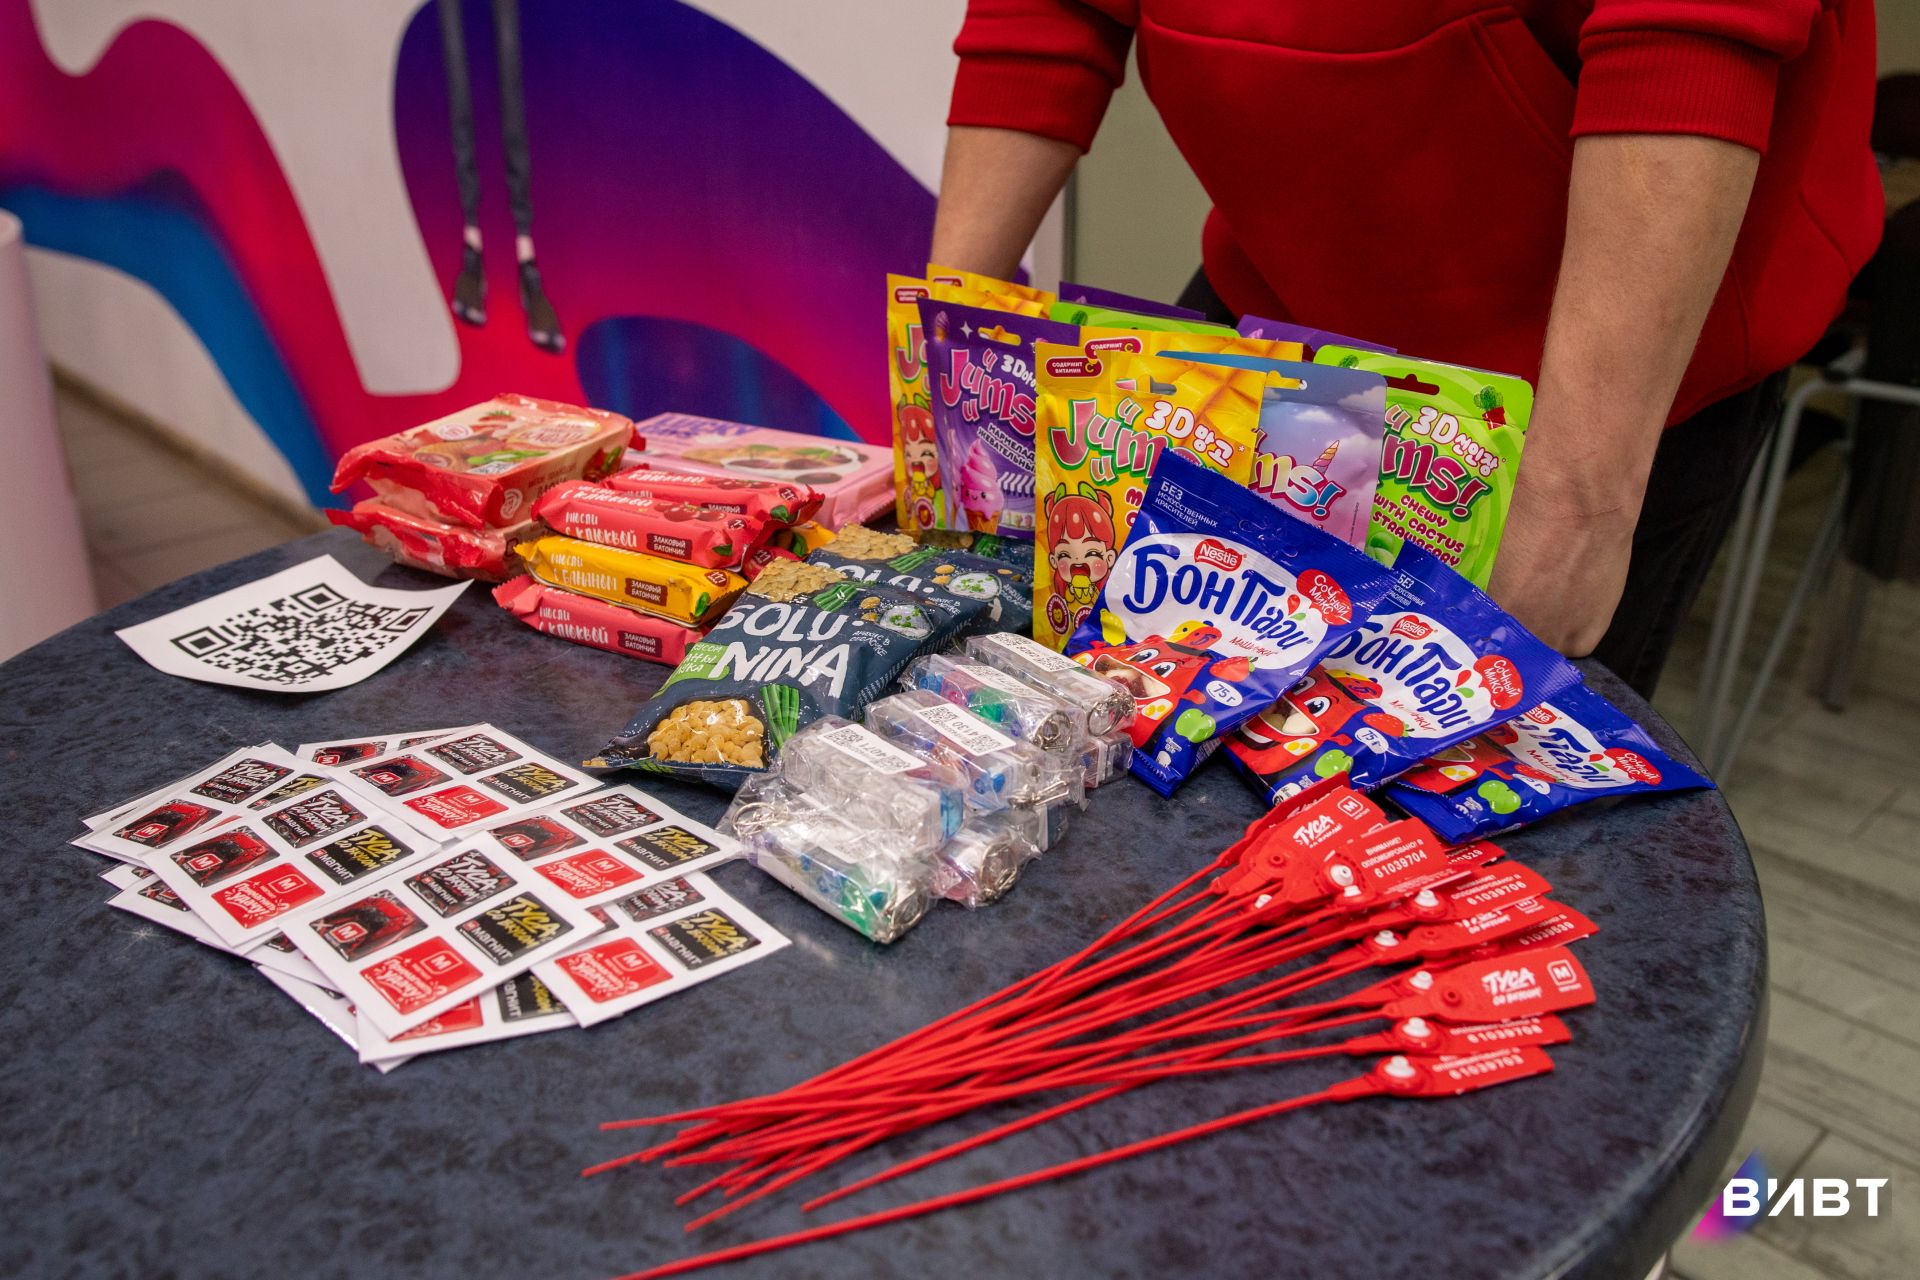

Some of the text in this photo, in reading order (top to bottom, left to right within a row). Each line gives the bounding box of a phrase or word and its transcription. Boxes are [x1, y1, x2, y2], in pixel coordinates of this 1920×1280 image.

[1160, 481, 1183, 501] БЕЗ
[1155, 497, 1198, 527] КРАСИТЕЛЕЙ
[1157, 490, 1219, 528] ИСКУССТВЕННЫХ
[1400, 494, 1448, 528] CHEWY
[1374, 493, 1465, 554] WITH CACTUS
[653, 535, 687, 549] ЗЛАКОВЫЙ
[654, 544, 686, 556] БАТОНЧИК
[631, 580, 662, 594] ЗЛАКОВЫЙ
[631, 588, 661, 602] БАТОНЧИК
[624, 632, 656, 646] ЗЛАКОВЫЙ
[625, 640, 656, 654] БАТОНЧИК
[709, 641, 850, 699] NINA
[1213, 683, 1231, 698] 75
[1293, 815, 1335, 845] ТУСА
[1374, 849, 1427, 878] 61039704
[1482, 967, 1536, 995] ТУСА
